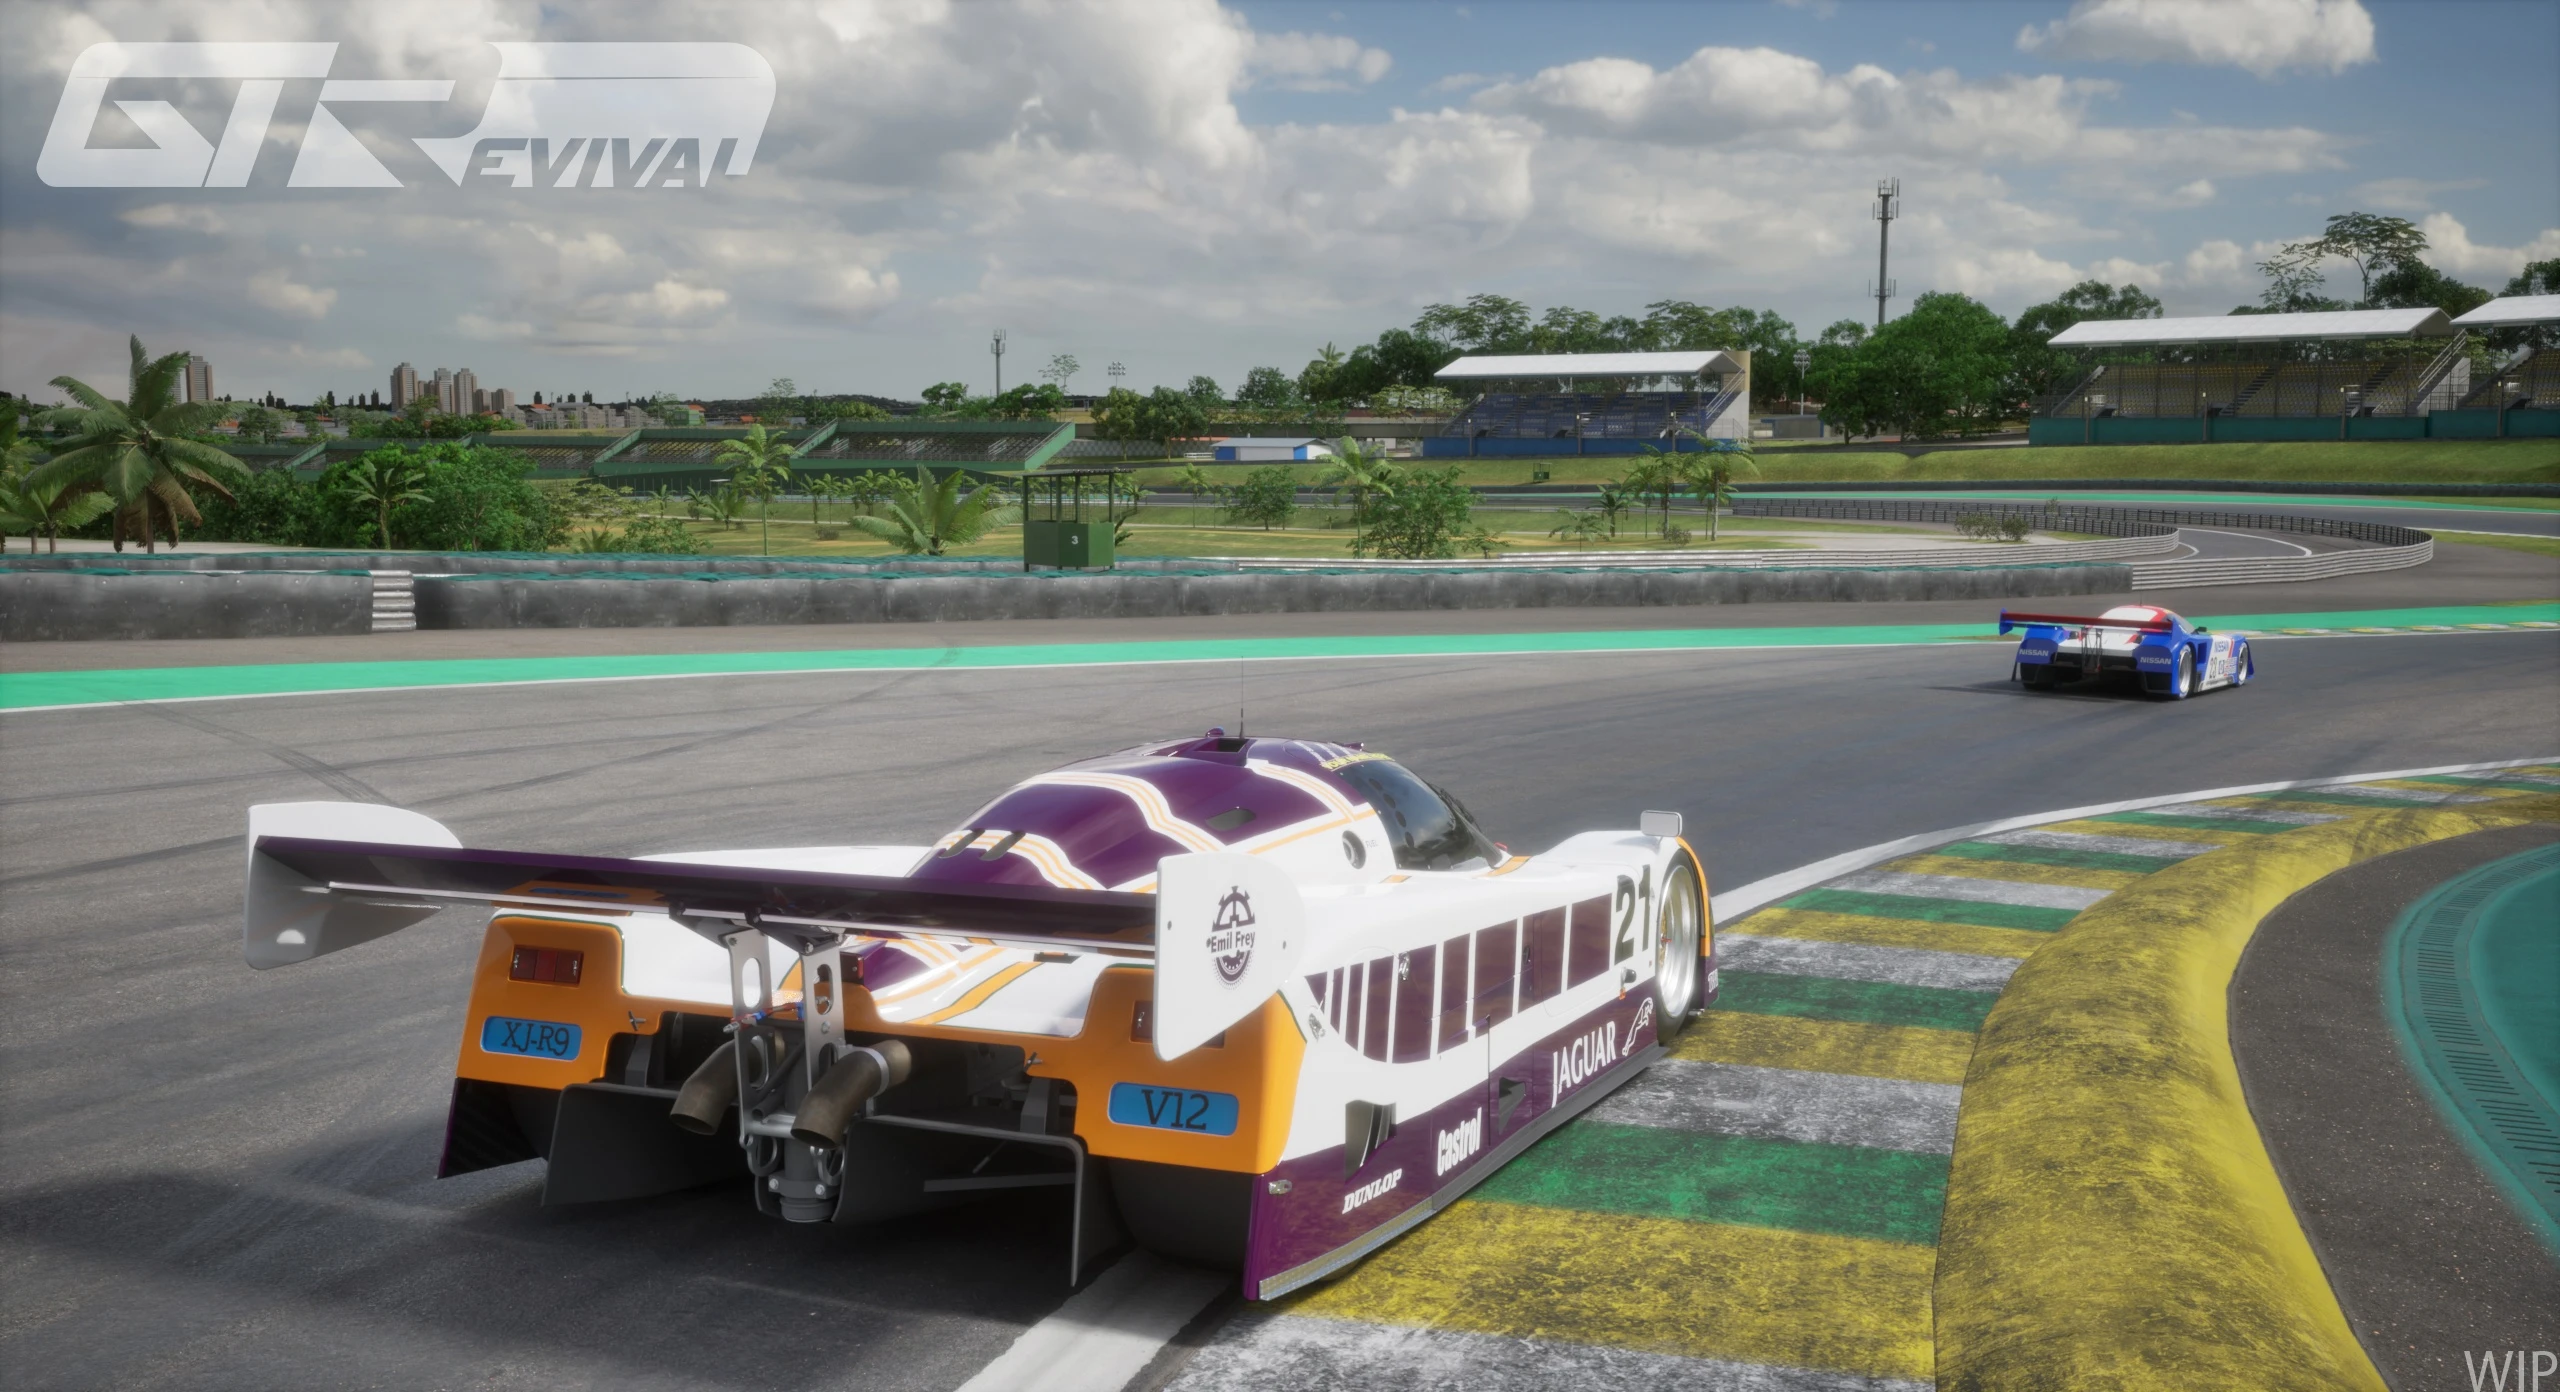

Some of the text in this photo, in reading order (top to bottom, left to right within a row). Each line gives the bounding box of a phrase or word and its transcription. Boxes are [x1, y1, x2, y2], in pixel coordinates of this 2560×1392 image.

[1071, 535, 1079, 545] 3
[2019, 648, 2049, 657] NISSAN
[2140, 656, 2172, 665] NISSAN
[1614, 864, 1650, 966] 21
[1211, 930, 1255, 953] Emil Frey
[502, 1021, 569, 1057] XJ-R9
[1551, 1020, 1617, 1109] JAGUAR
[1141, 1089, 1209, 1131] V12
[1437, 1107, 1482, 1177] Castrol
[1342, 1168, 1403, 1215] DUNLOP
